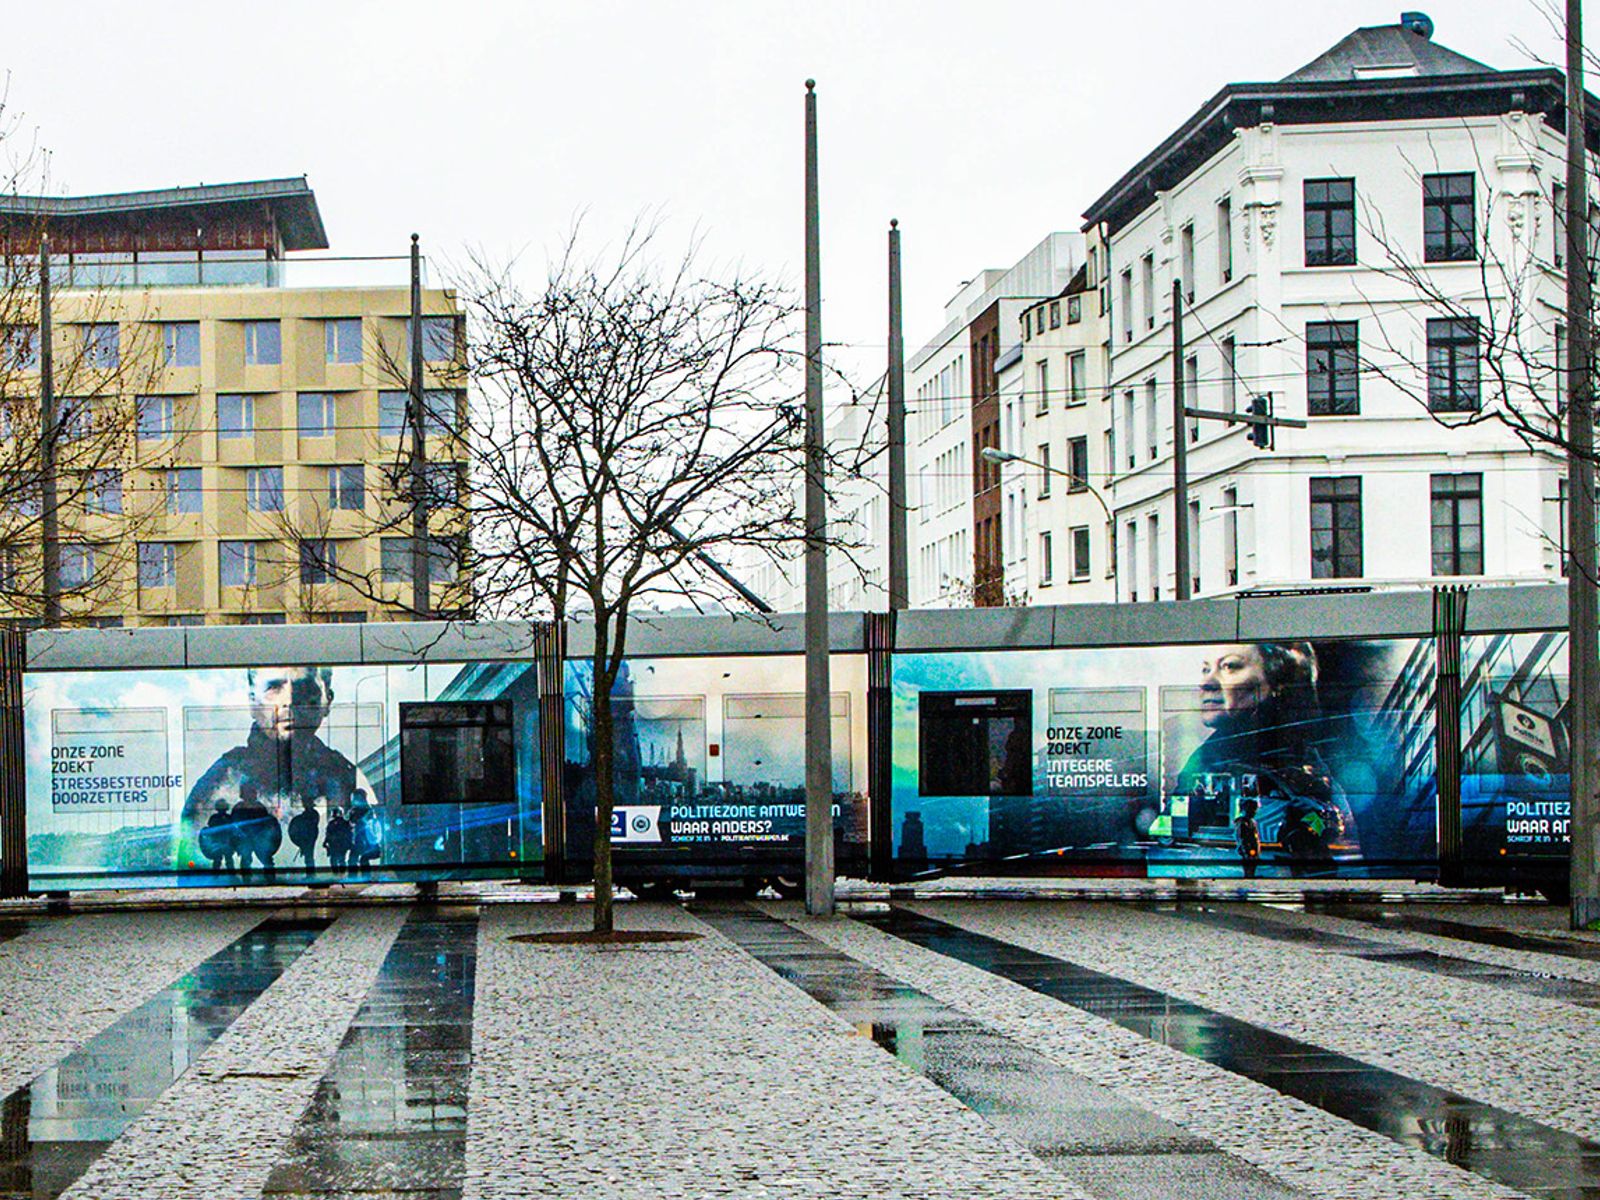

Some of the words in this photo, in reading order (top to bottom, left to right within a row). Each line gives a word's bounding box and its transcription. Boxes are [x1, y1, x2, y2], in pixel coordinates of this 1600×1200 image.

[1046, 726, 1083, 740] ONZE
[1086, 726, 1122, 739] ZONE
[51, 746, 86, 759] ONZE
[90, 745, 125, 758] ZONE
[1046, 742, 1091, 755] ZOEKT
[51, 760, 95, 774] ZOEKT
[1046, 759, 1114, 773] INTEGERE
[51, 775, 183, 790] STRESSBESTENDIGE
[1046, 773, 1148, 788] TEAMSPELERS
[51, 790, 148, 805] DOORZETTERS
[671, 804, 757, 818] POLITIEZONE
[759, 803, 841, 818] ANTWEN
[1506, 802, 1571, 816] POLITIEZ
[670, 820, 710, 834] WAAR
[712, 820, 772, 834] ANDERS?
[1506, 819, 1549, 833] WAAR
